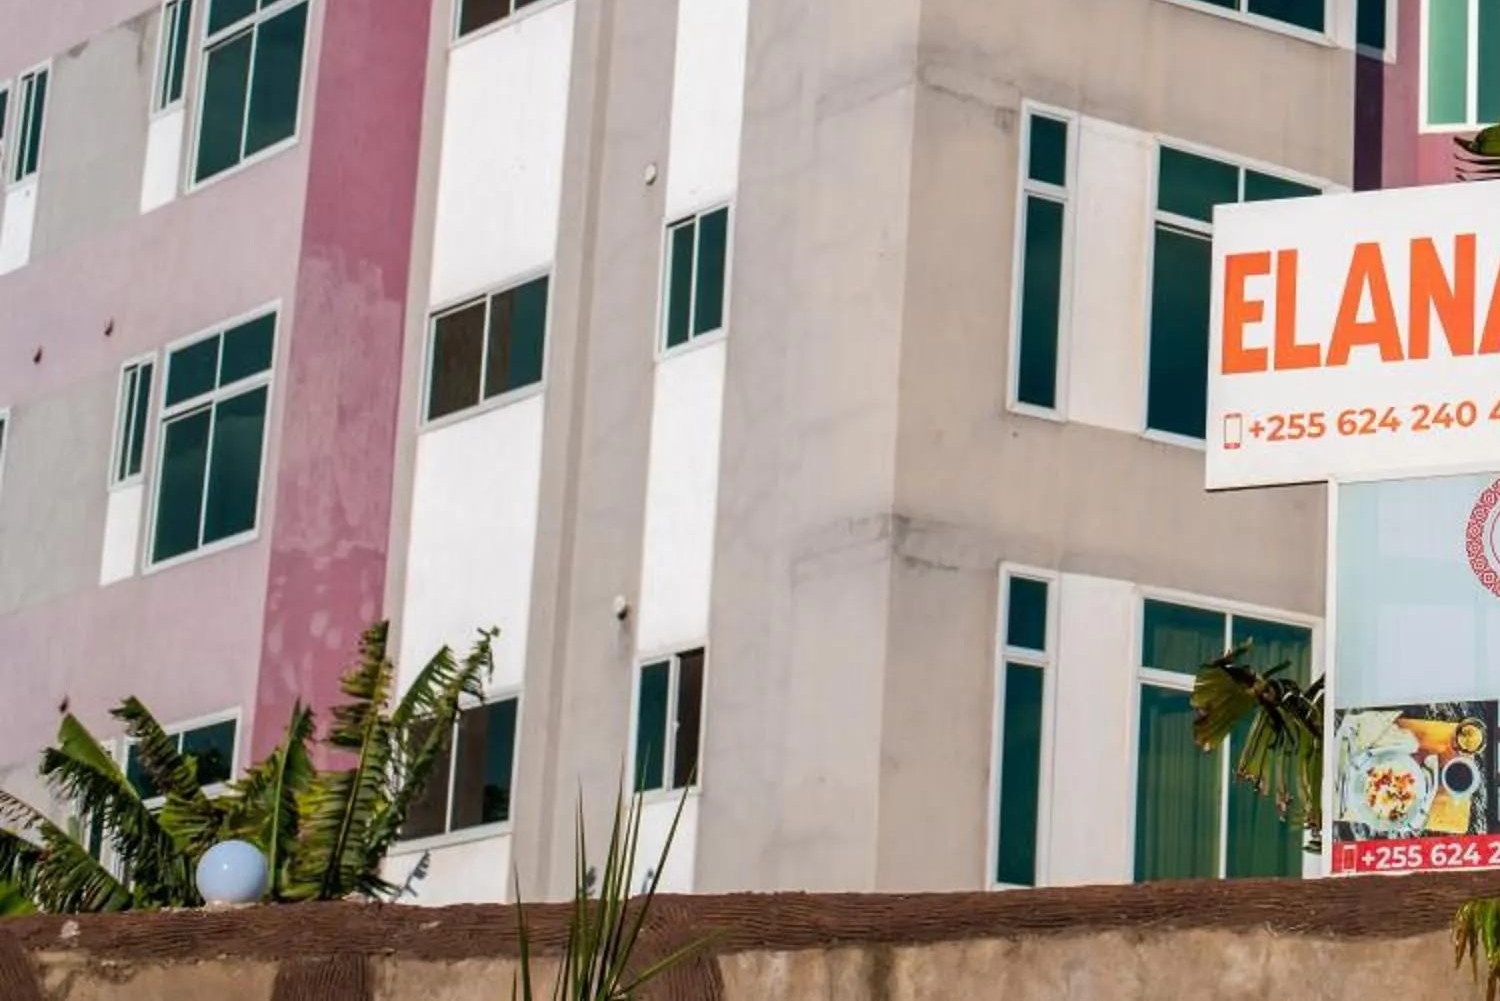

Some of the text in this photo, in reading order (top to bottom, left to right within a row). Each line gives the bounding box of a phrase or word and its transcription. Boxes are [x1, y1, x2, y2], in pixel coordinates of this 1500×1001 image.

[1248, 413, 1326, 442] +255
[1336, 407, 1401, 436] 624
[1410, 401, 1478, 431] 240
[1361, 845, 1423, 871] +255
[1431, 842, 1482, 866] 624
